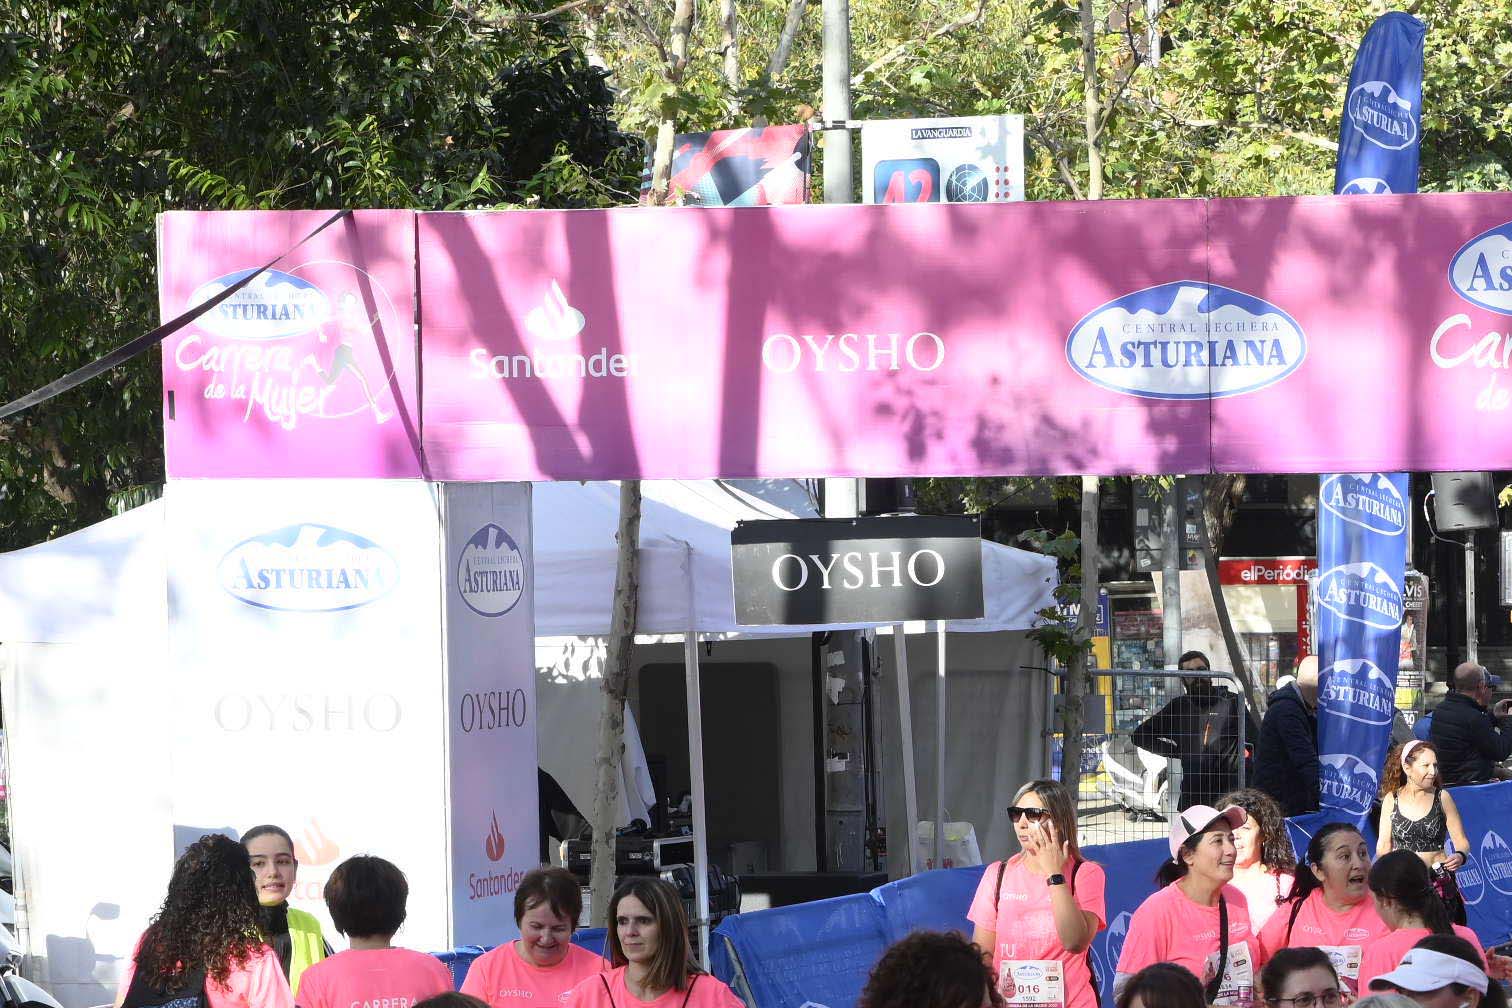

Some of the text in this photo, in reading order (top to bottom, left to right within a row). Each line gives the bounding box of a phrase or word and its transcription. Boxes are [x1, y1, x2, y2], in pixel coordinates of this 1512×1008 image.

[922, 127, 972, 138] VANGUARDIA
[1085, 325, 1288, 370] ASTURIANA
[1122, 320, 1281, 335] CENTRAL LECHERA
[175, 334, 298, 373] Carrera
[469, 348, 640, 379] Santander
[763, 332, 946, 374] OYSHO
[204, 366, 337, 431] de la Mujer
[1476, 371, 1511, 411] de
[1329, 482, 1402, 527] ASTURIANA
[233, 556, 385, 590] ASTURIANA
[463, 558, 520, 595] ASTURIANA
[772, 549, 946, 592] OYSHO
[1325, 576, 1400, 621] ASTURIANA
[1404, 585, 1423, 597] VIS
[213, 692, 402, 733] OYSHO
[460, 688, 527, 733] OYSHO
[1320, 675, 1392, 717] ASTURIANA
[500, 989, 533, 999] OYSHO
[1018, 984, 1040, 994] 016
